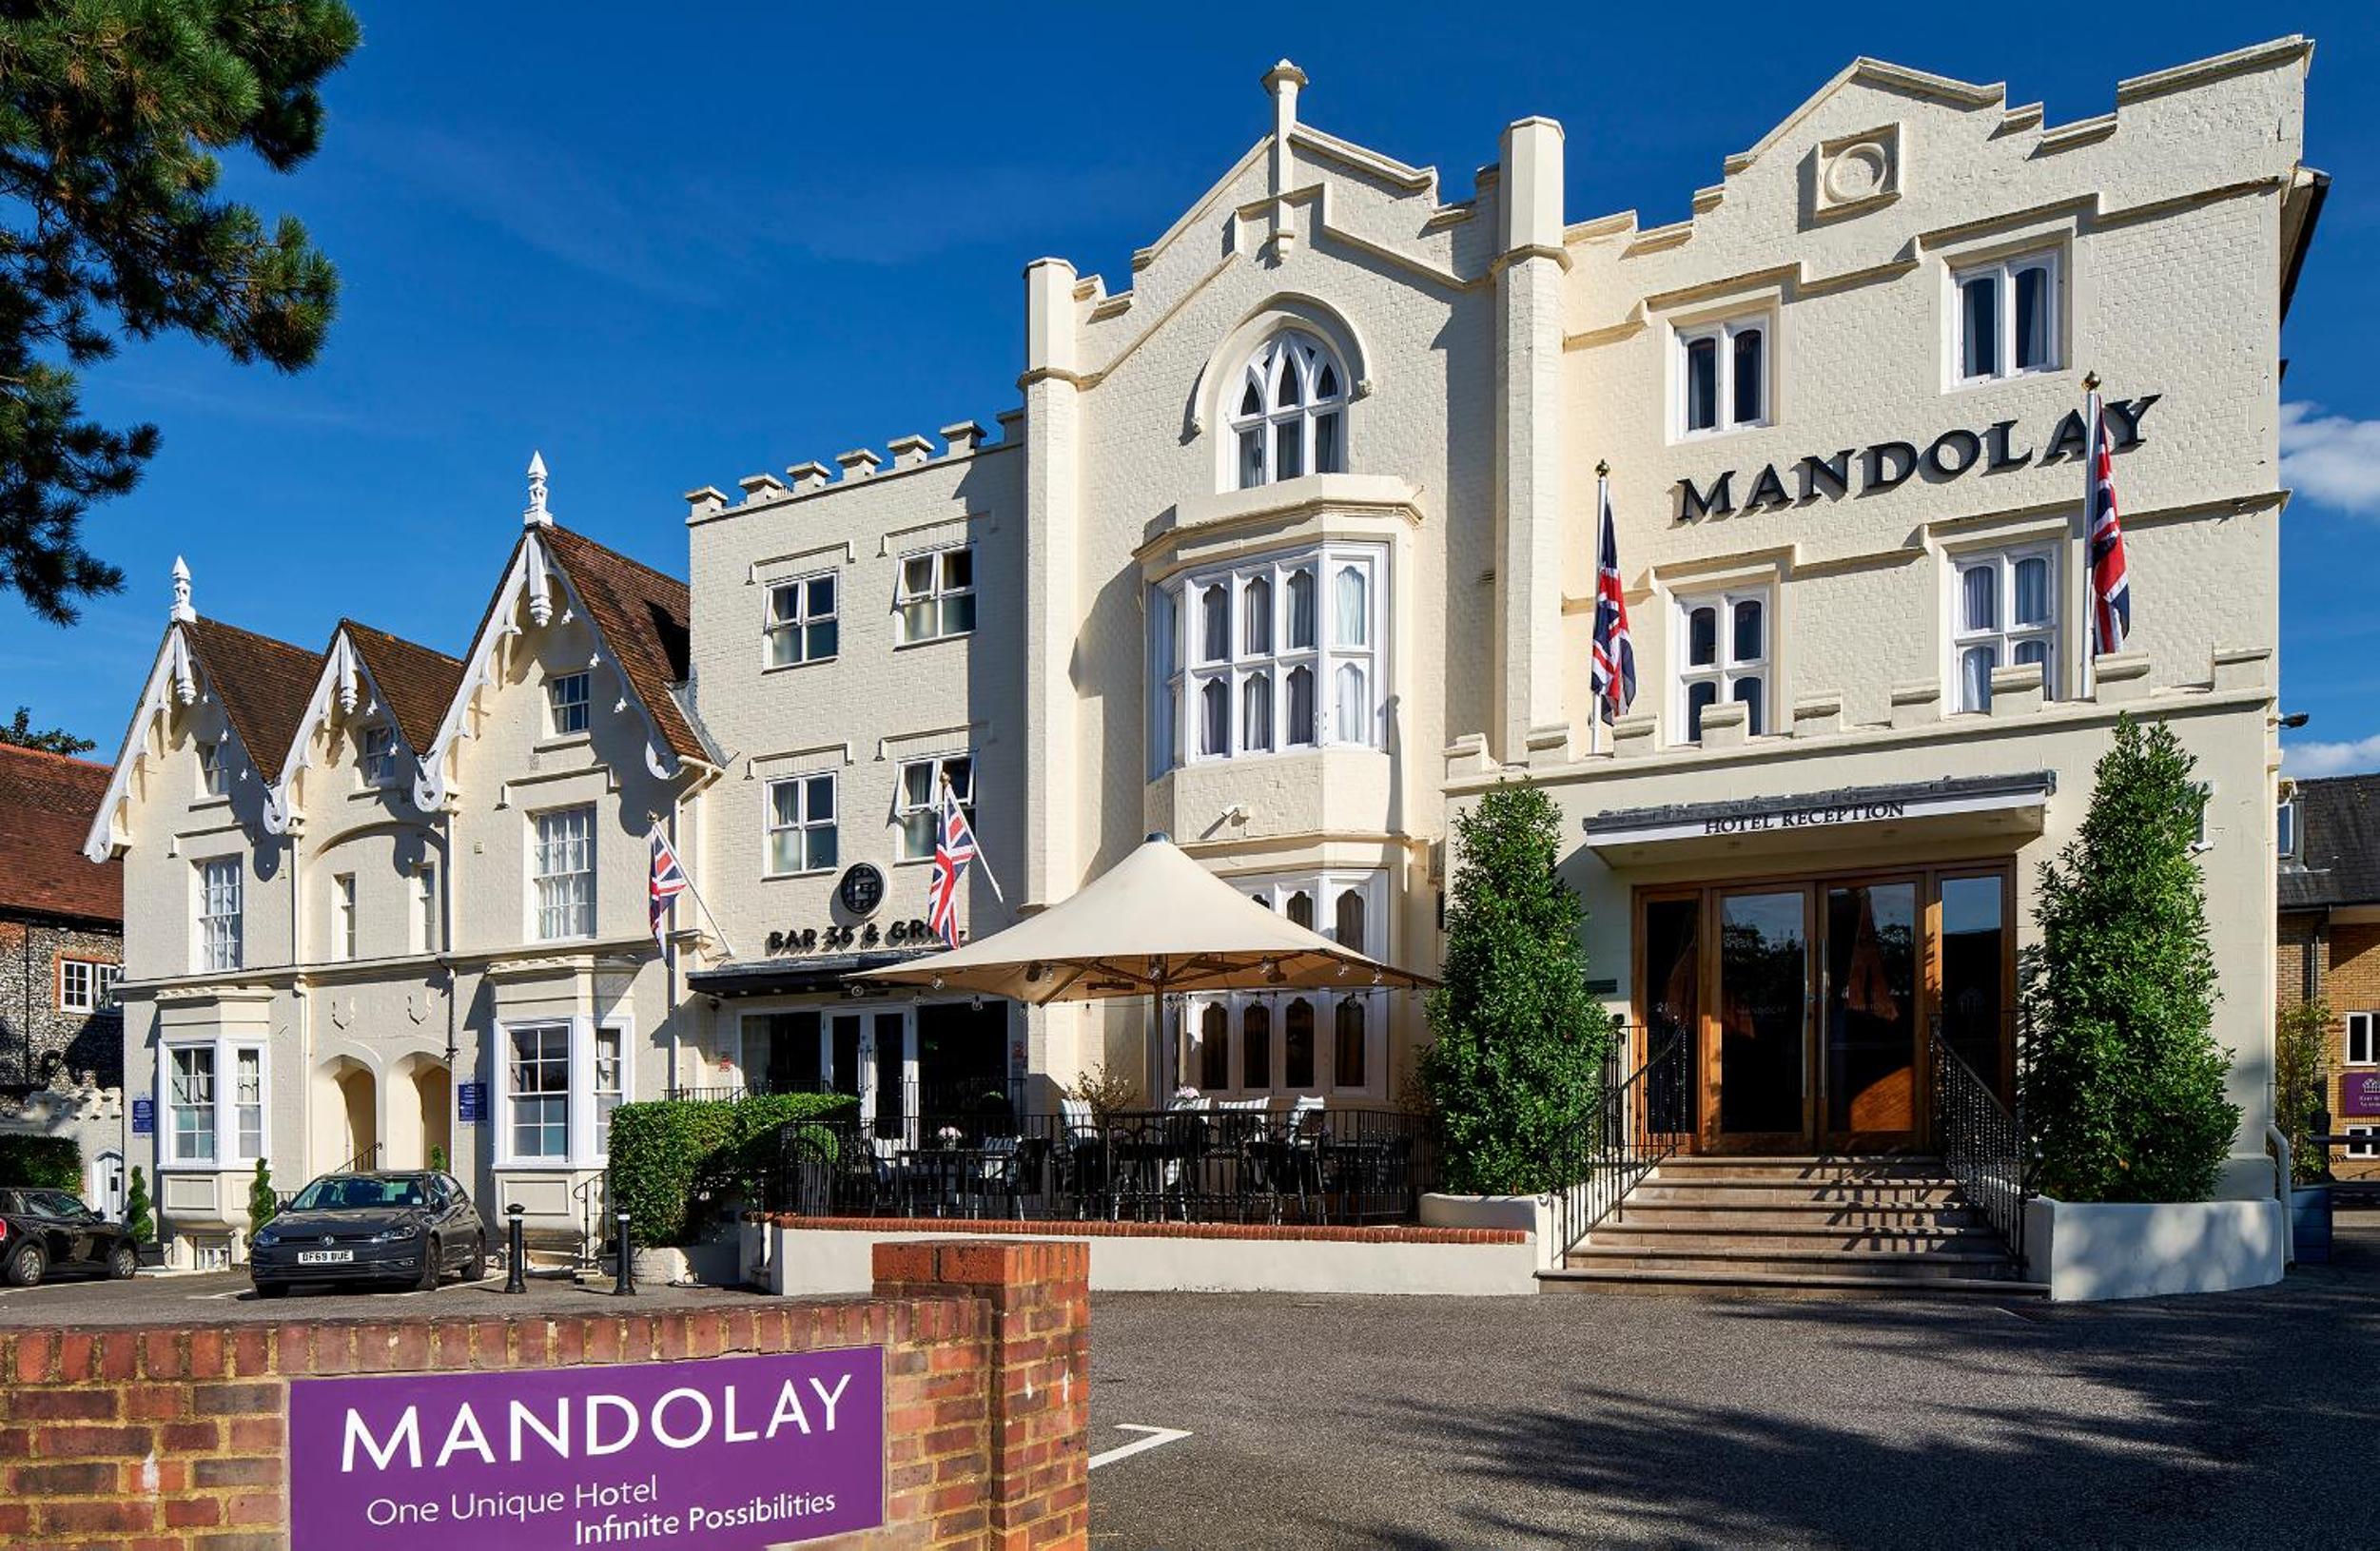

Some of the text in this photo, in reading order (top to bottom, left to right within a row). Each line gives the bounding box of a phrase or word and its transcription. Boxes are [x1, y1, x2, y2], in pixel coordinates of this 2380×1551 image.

[1676, 394, 2163, 521] MANDOLAY
[1705, 803, 1904, 835] HOTEL RECEPTION
[769, 919, 966, 949] BAR 36 & GRI
[341, 1374, 852, 1472] MANDOLAY
[367, 1475, 657, 1525] One Unique Hotel
[576, 1491, 837, 1545] Infinite Possibilities
